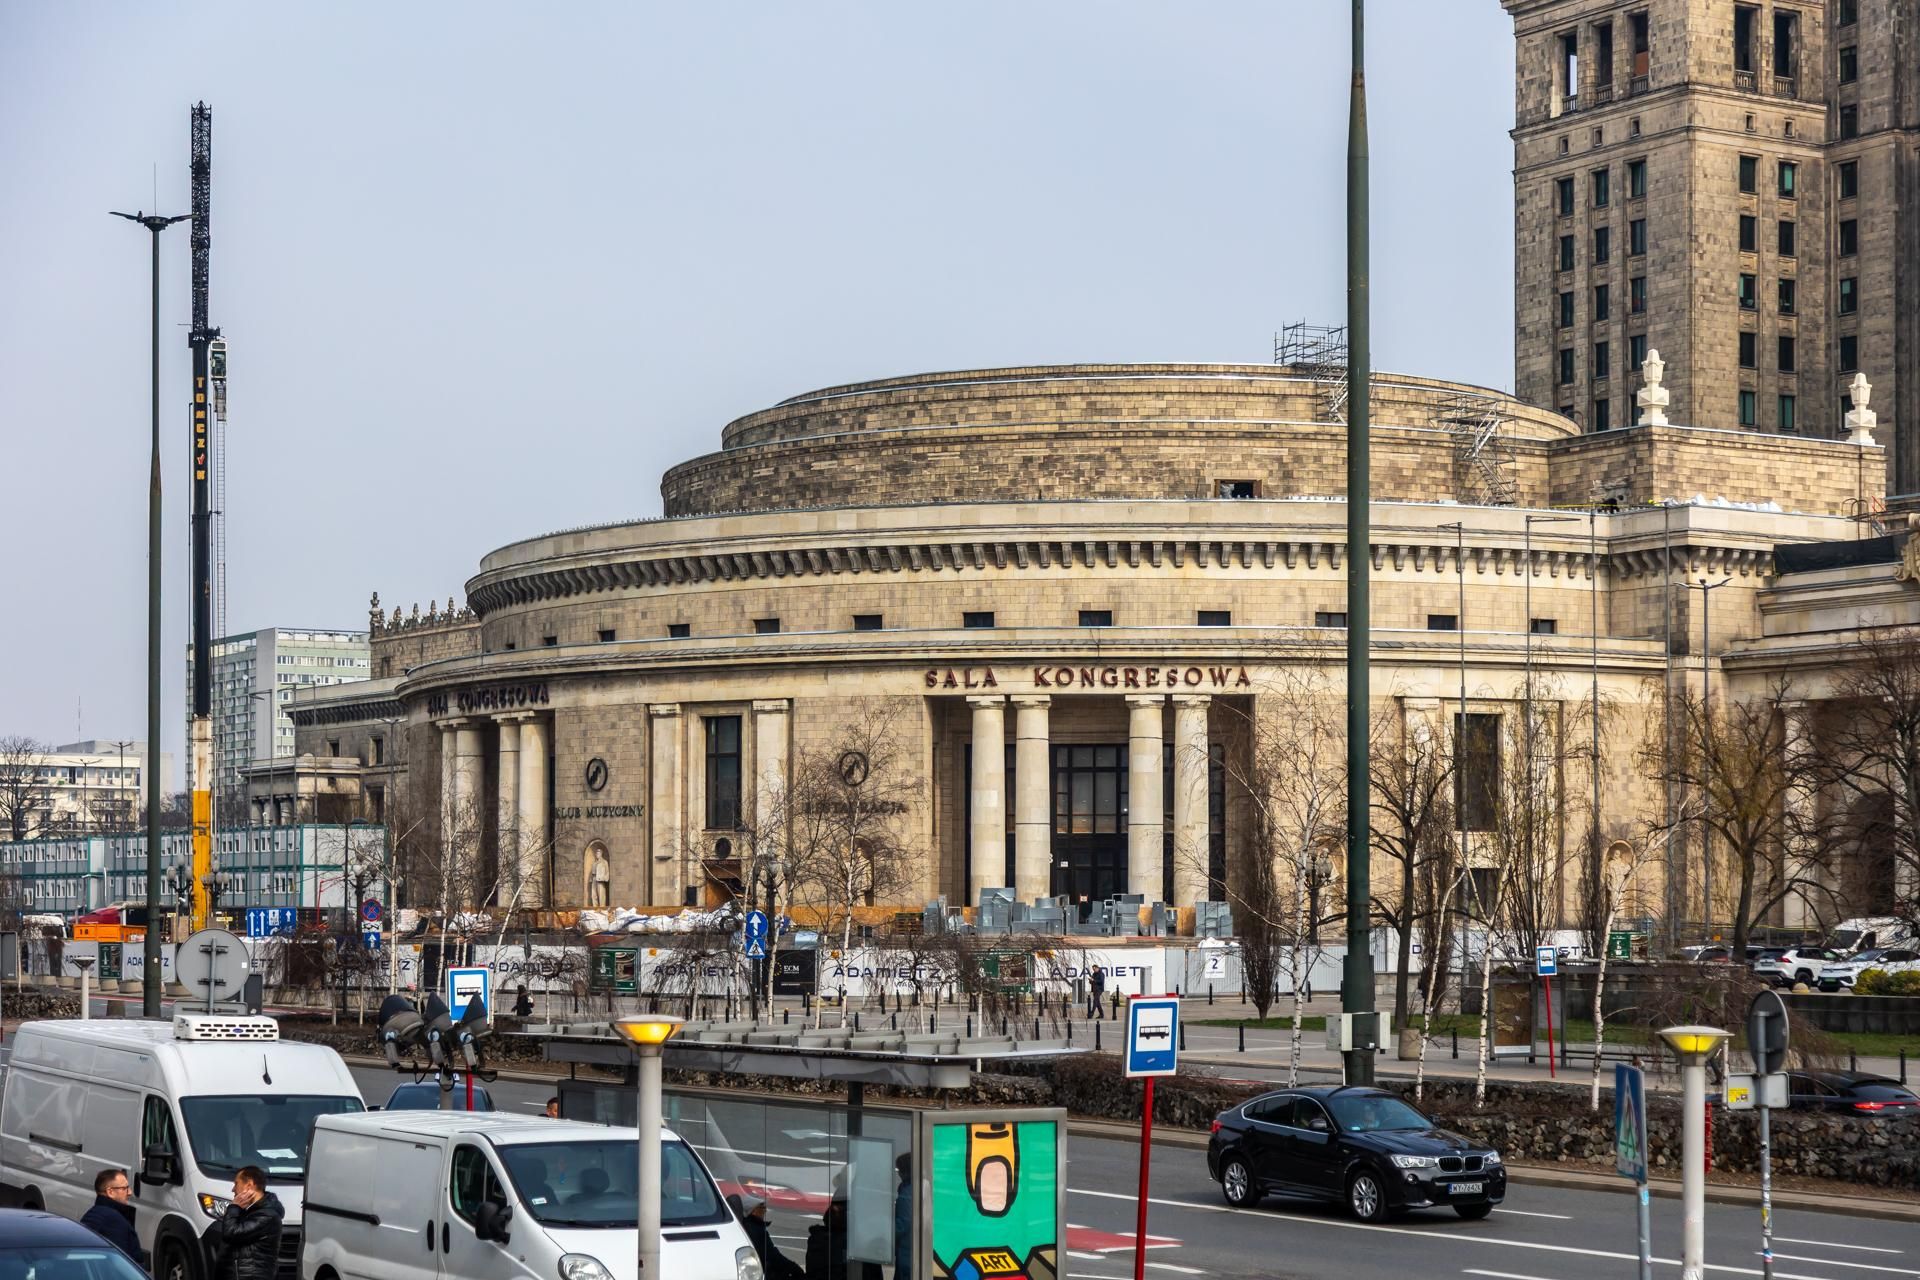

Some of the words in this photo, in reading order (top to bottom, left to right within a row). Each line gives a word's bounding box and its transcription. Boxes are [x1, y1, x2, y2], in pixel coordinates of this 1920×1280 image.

[924, 667, 999, 688] SALA
[1033, 666, 1252, 688] KONGRESOWA
[555, 807, 581, 819] KLUB
[586, 805, 644, 818] MUZYCZNY
[1212, 958, 1218, 970] 2
[833, 967, 942, 978] ADAMIETZ
[980, 1255, 1012, 1270] ART
